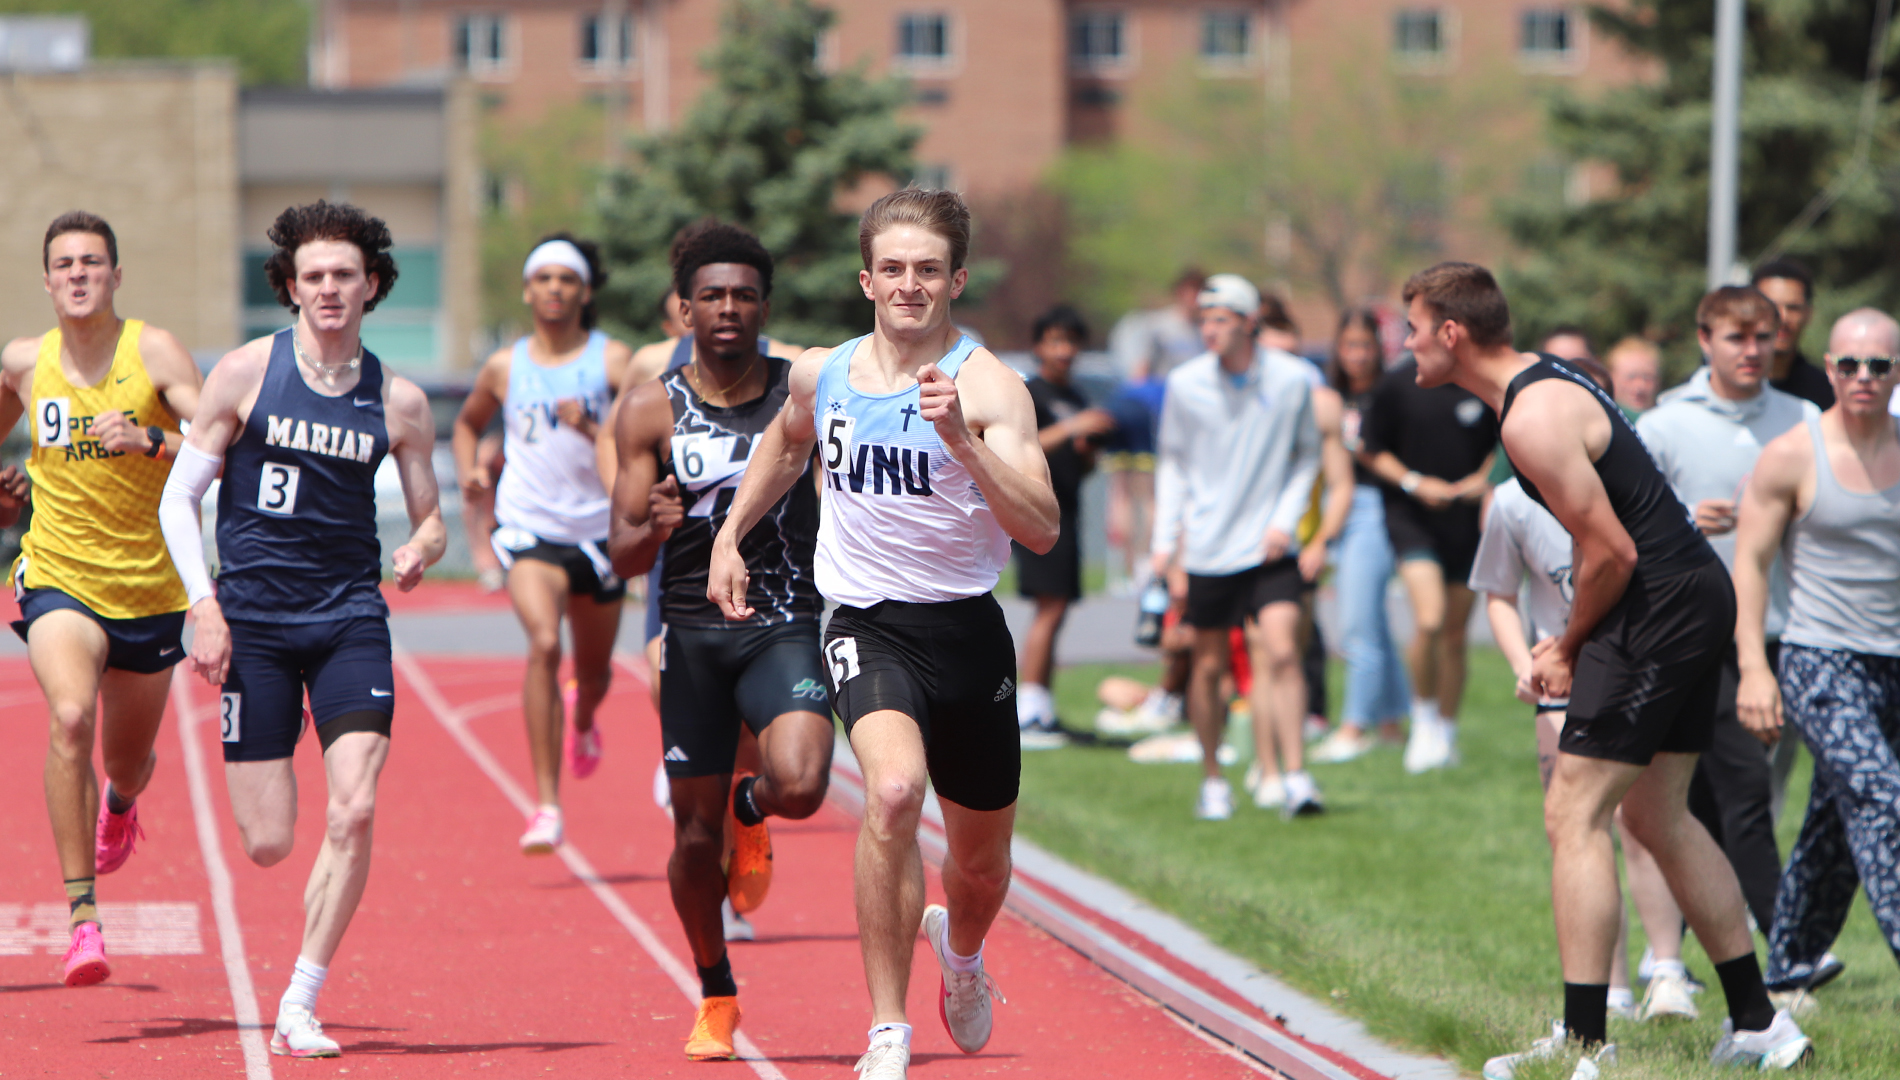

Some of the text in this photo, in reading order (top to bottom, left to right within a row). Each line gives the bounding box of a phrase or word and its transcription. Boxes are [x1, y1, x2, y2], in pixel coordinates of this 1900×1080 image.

[43, 401, 61, 442] 9
[265, 414, 375, 464] MARIAN
[523, 411, 538, 444] 2
[682, 436, 704, 479] 6
[827, 418, 846, 470] 5
[265, 466, 289, 509] 3
[829, 639, 850, 686] 5
[222, 695, 232, 739] 3
